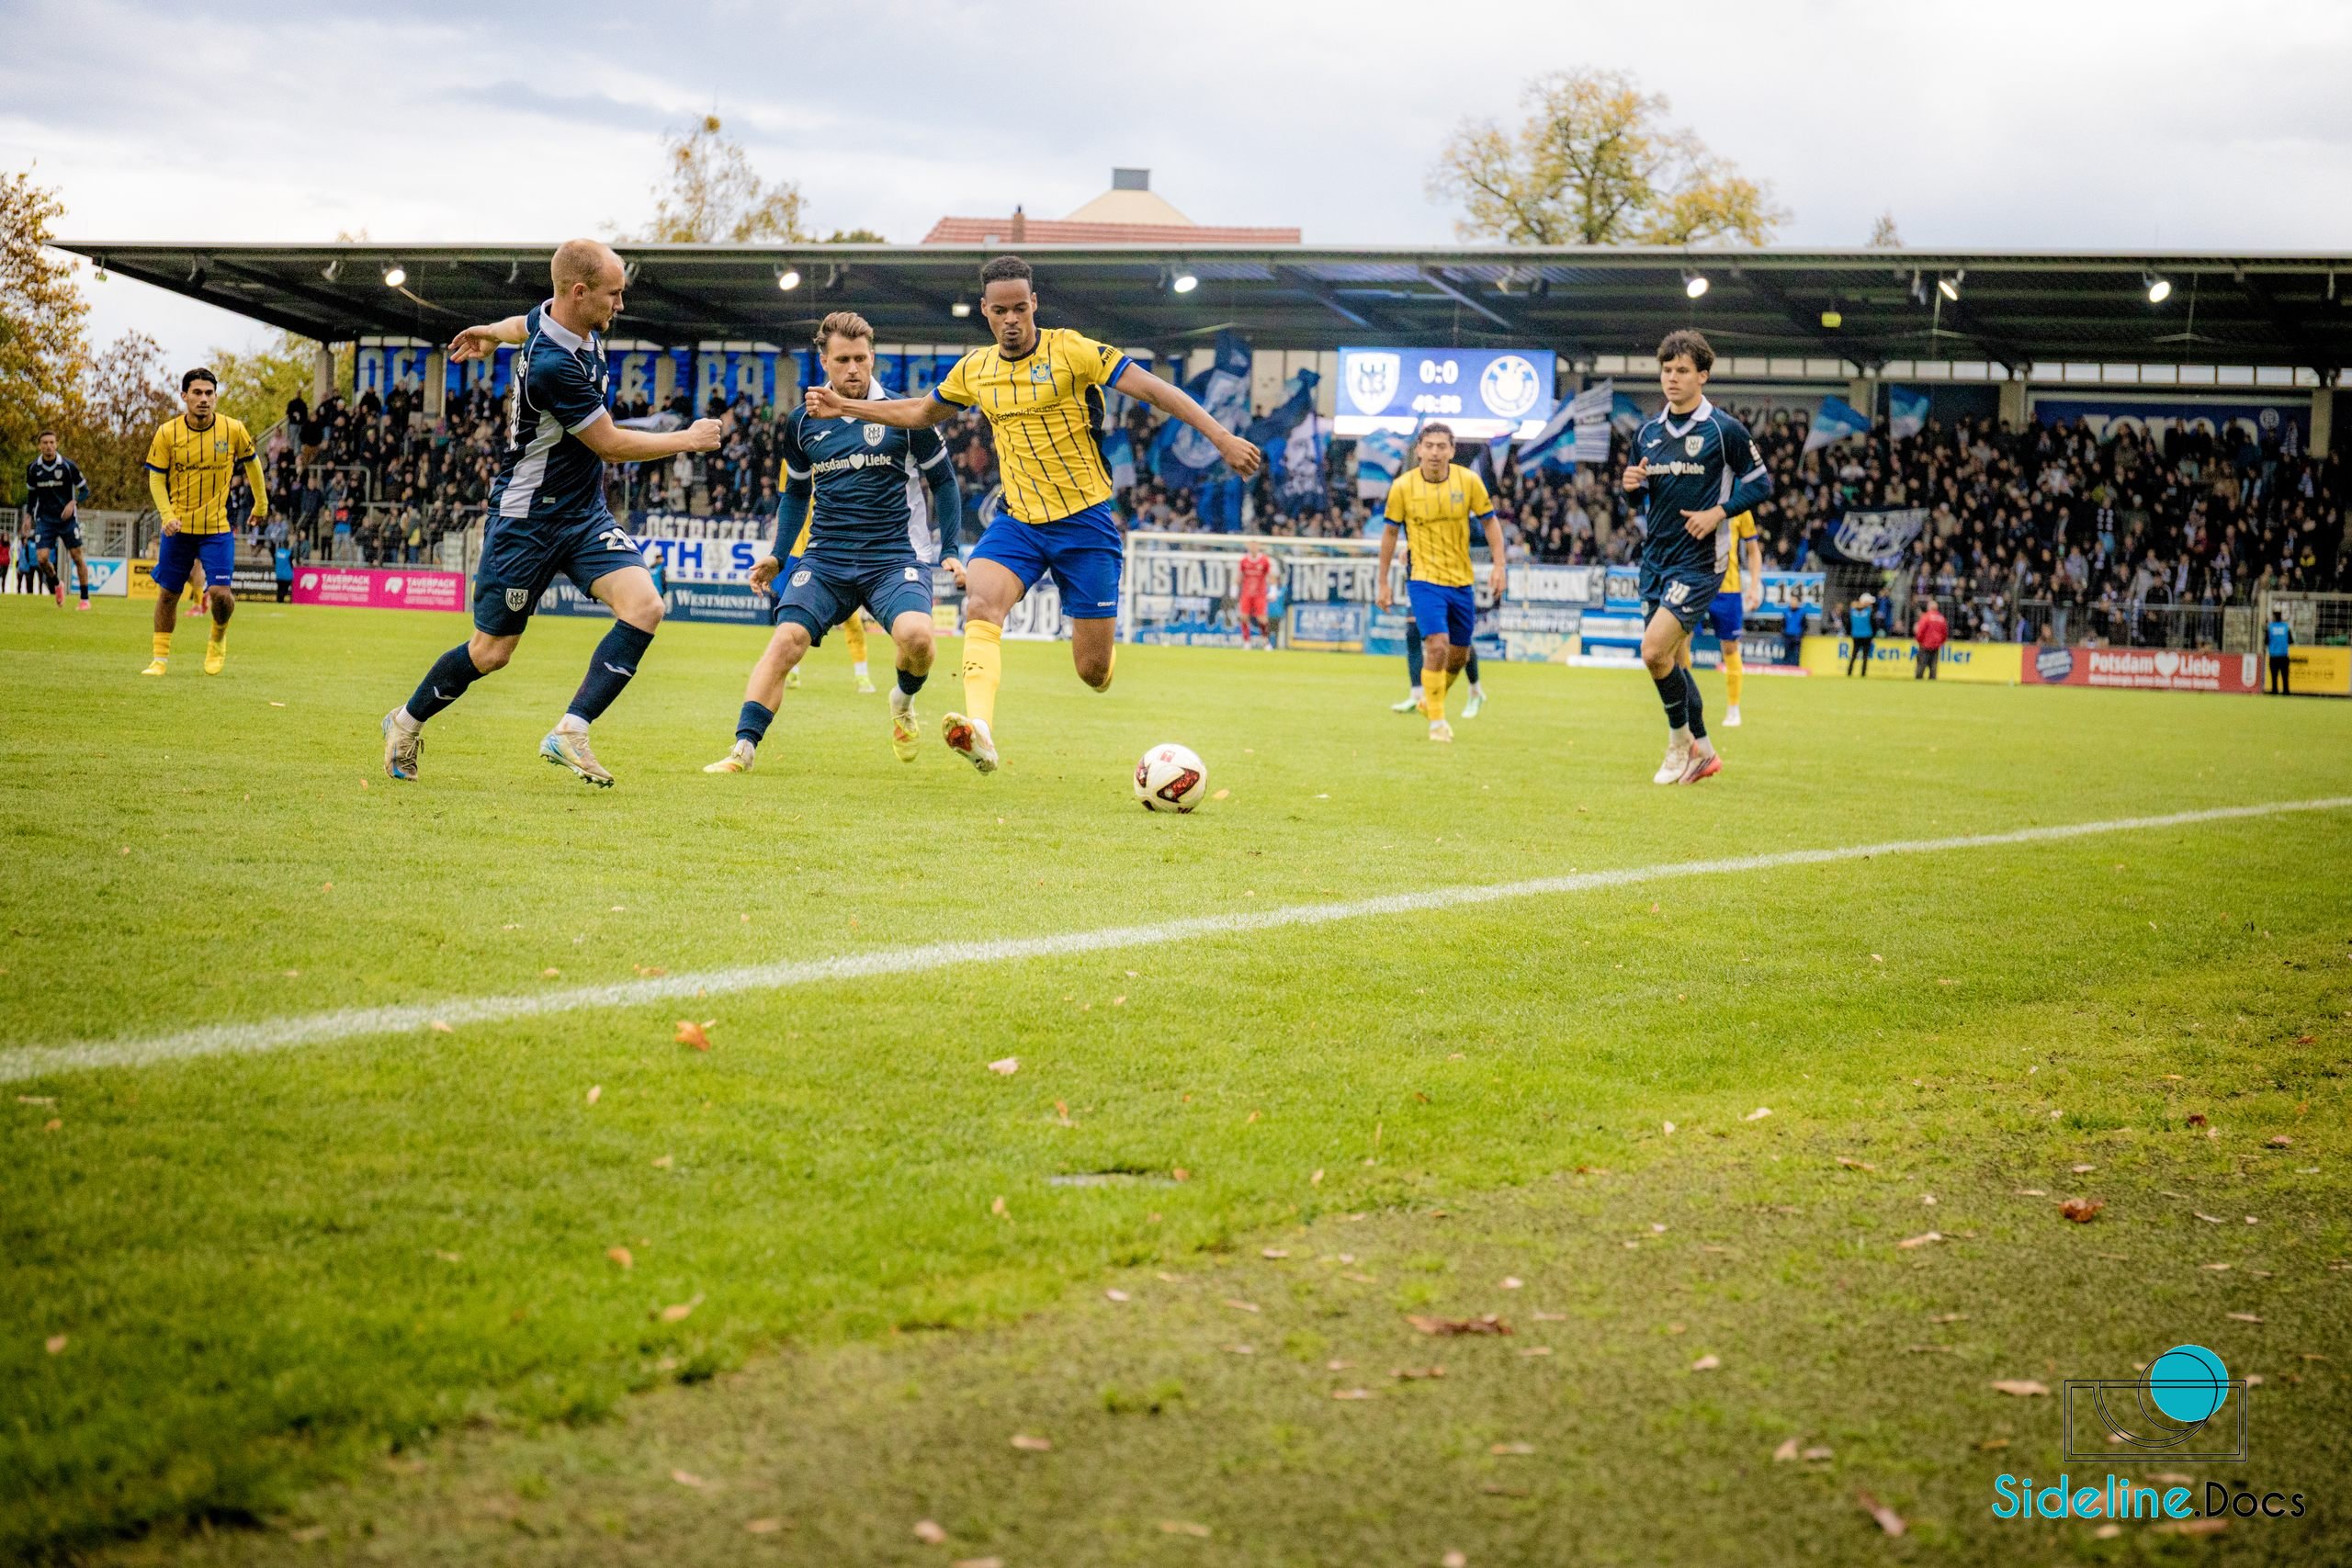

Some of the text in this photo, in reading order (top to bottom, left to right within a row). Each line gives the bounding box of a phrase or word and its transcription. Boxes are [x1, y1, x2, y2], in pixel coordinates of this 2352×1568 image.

[1419, 359, 1459, 385] 0:0
[865, 453, 891, 467] Liebe
[1682, 462, 1705, 475] Liebe
[904, 567, 920, 583] 8
[1664, 581, 1690, 605] 10
[2088, 651, 2154, 674] Potsdam
[2180, 654, 2221, 677] Liebe
